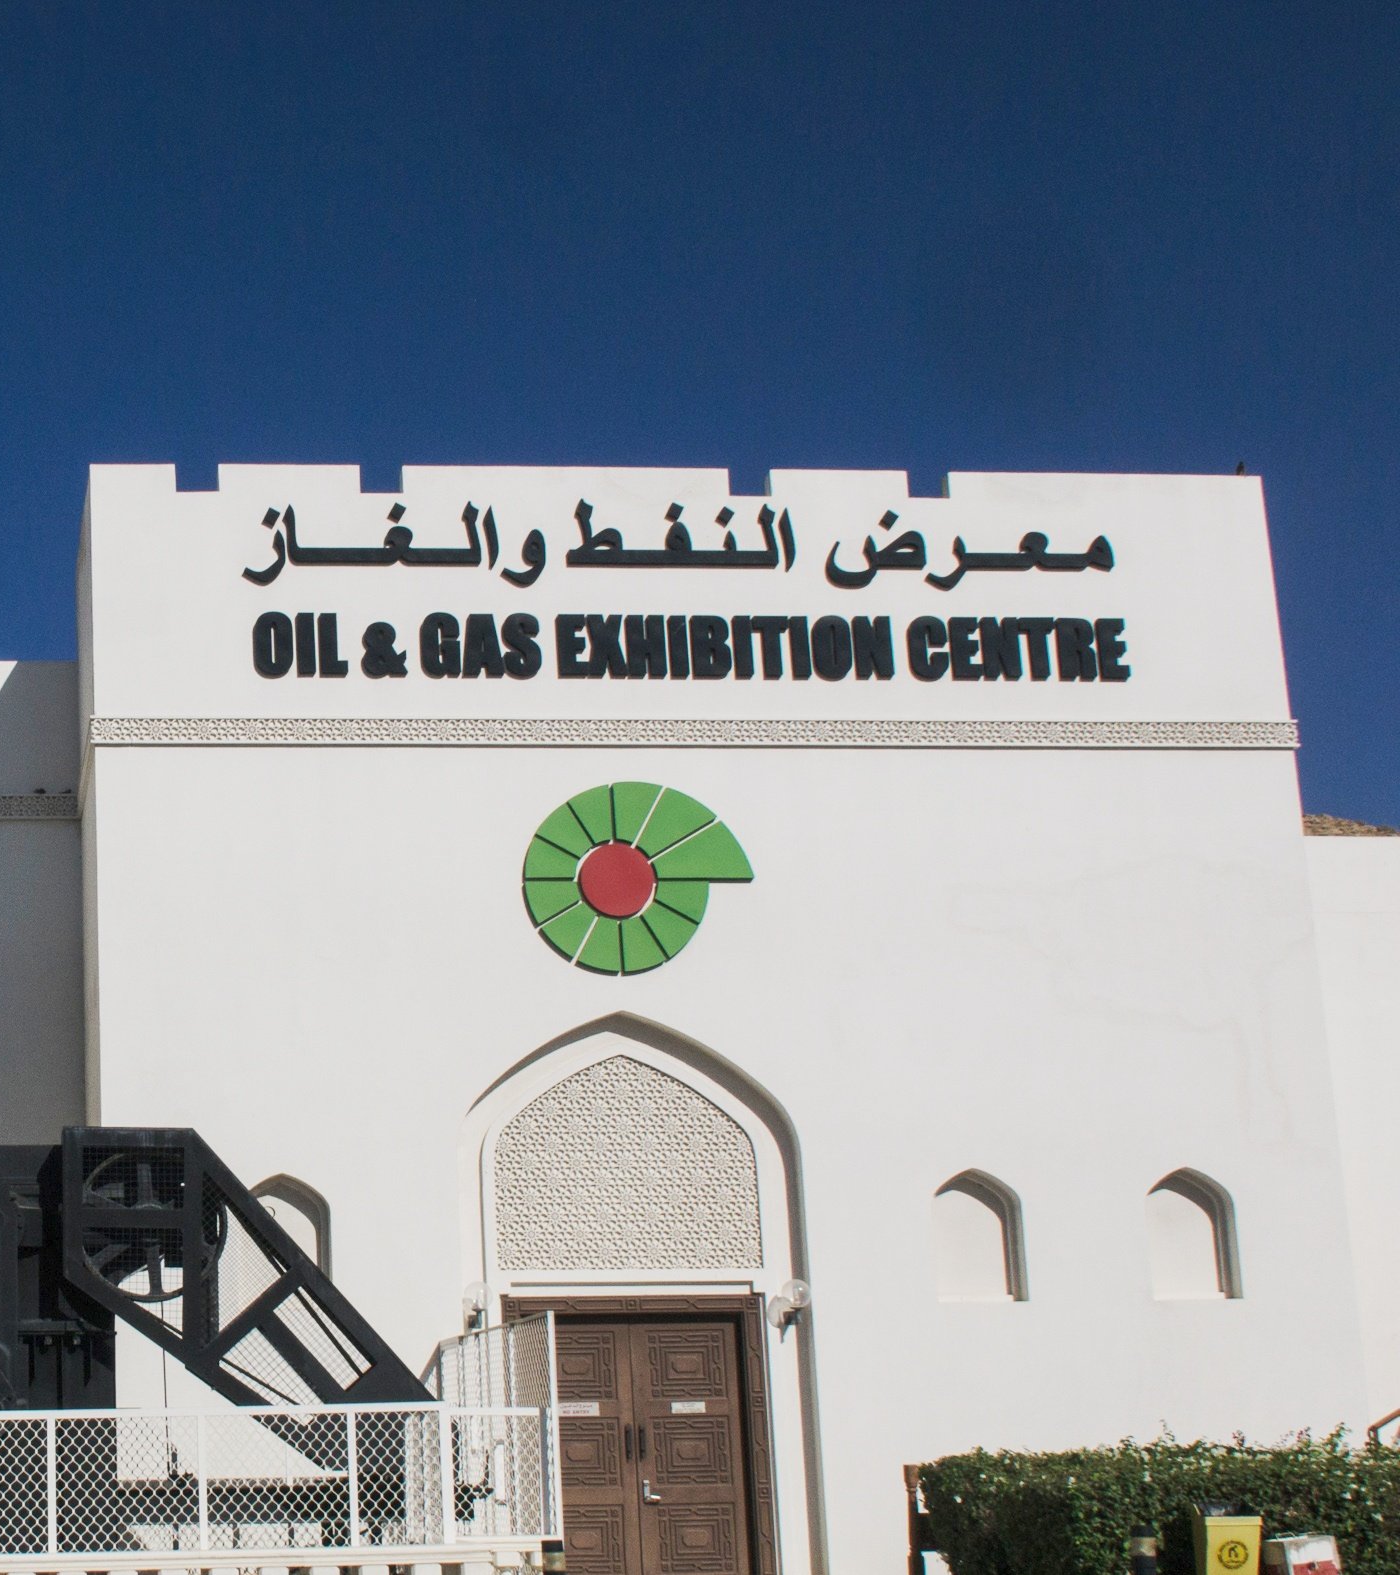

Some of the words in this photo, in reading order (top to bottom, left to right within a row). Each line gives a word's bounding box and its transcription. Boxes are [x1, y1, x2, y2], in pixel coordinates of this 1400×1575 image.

[241, 501, 547, 589] والغاز
[565, 498, 797, 574] النفط
[825, 509, 1115, 592] معرض
[252, 611, 349, 680] OIL
[360, 621, 409, 680] &
[419, 612, 543, 681] GAS
[554, 613, 896, 682] EXHIBITION
[906, 615, 1132, 683] CENTRE
